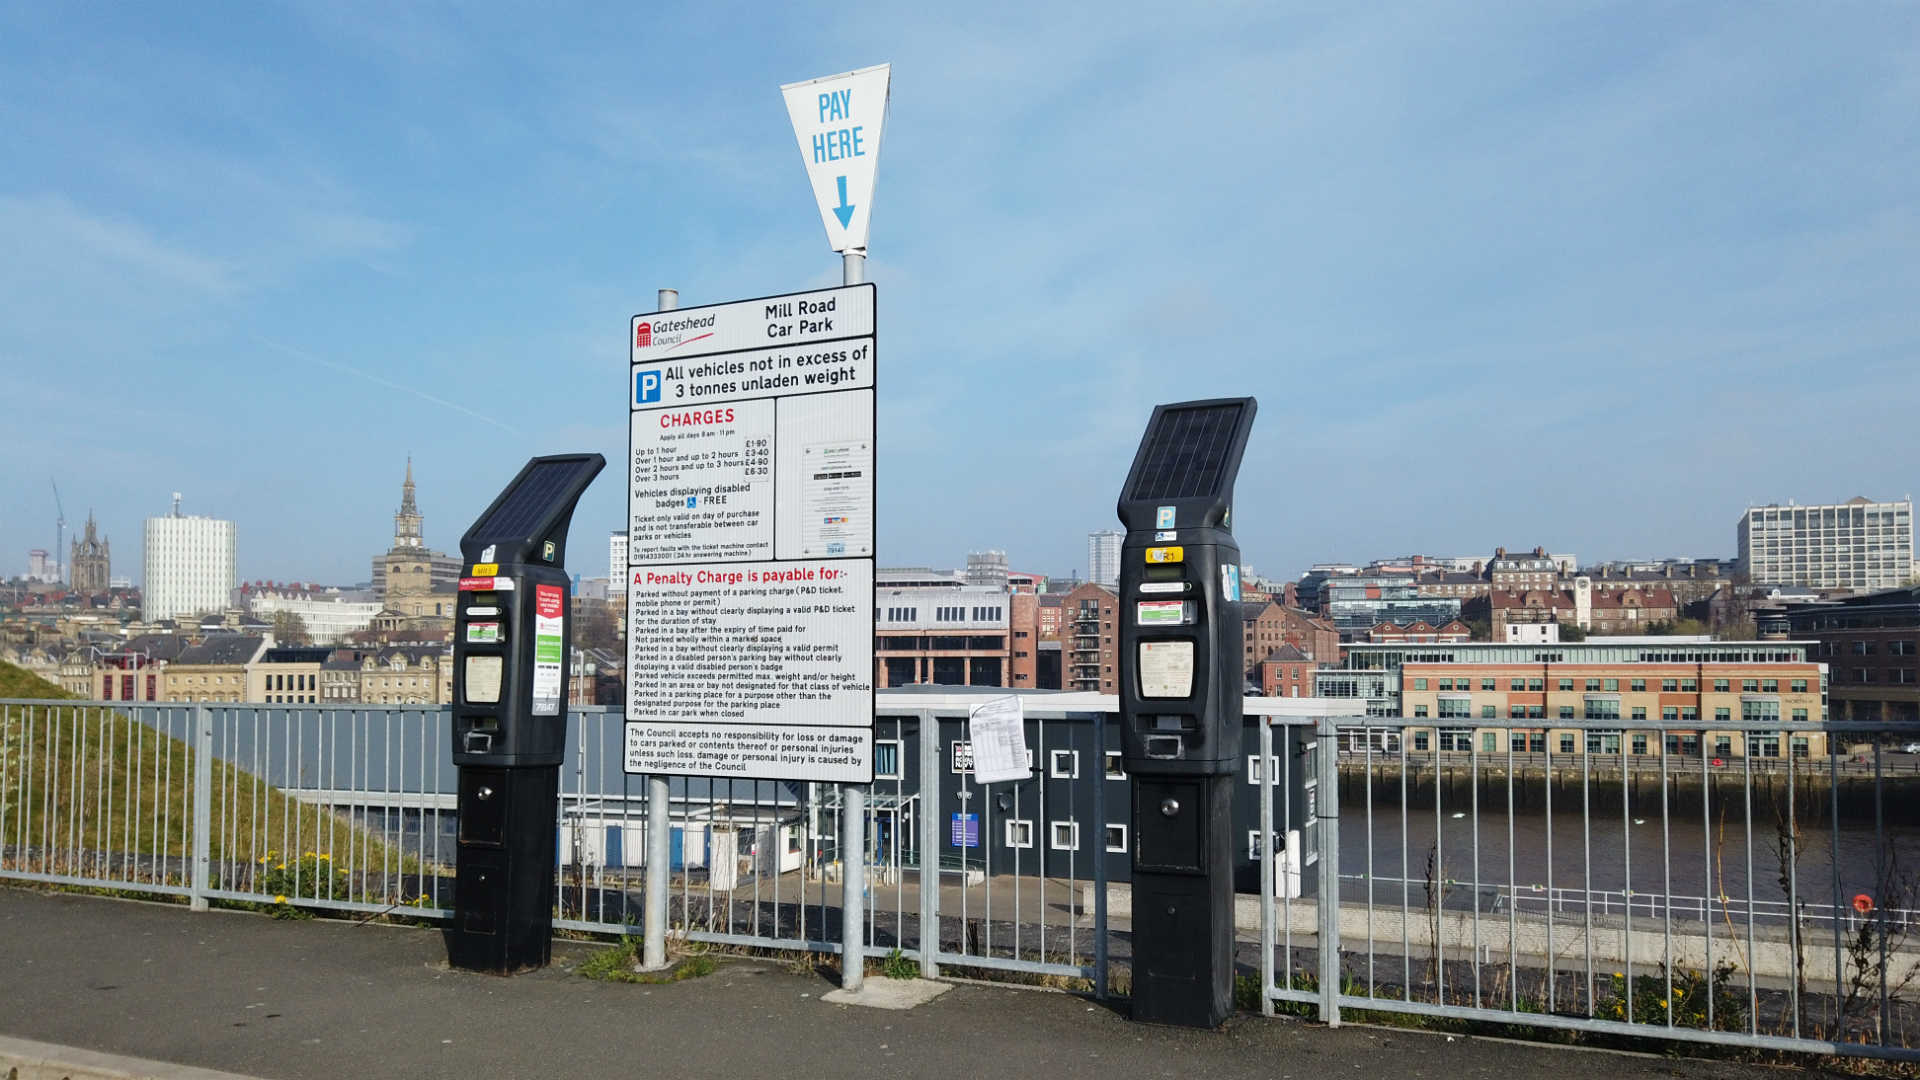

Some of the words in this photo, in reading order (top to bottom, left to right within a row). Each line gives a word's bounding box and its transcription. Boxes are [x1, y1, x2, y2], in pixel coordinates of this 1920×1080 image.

[818, 88, 851, 124] PAY
[812, 126, 865, 164] HERE
[765, 302, 793, 320] Mill
[798, 296, 836, 316] Road
[652, 313, 716, 334] Gateshead
[767, 323, 793, 338] Car
[799, 316, 833, 335] Park
[652, 334, 682, 346] Council
[665, 366, 684, 381] All
[688, 360, 745, 379] vehicles
[749, 356, 774, 372] not
[778, 354, 791, 369] in
[796, 351, 847, 367] excess
[852, 344, 868, 361] of
[642, 374, 658, 401] P
[675, 384, 685, 398] 3
[689, 381, 737, 397] tonnes
[741, 374, 799, 391] unladen
[804, 366, 856, 385] weight
[660, 408, 735, 429] CHARGES
[635, 448, 646, 457] Up
[635, 457, 651, 465] Over
[676, 454, 689, 462] and
[690, 454, 700, 462] up
[718, 451, 739, 459] hours
[635, 466, 651, 474] Over
[659, 464, 679, 472] hours
[681, 462, 694, 471] and
[706, 461, 715, 469] to
[723, 459, 744, 467] hours
[635, 475, 651, 483] Over
[634, 488, 668, 499] Vehicles
[669, 487, 712, 497] displaying
[714, 482, 751, 494] disabled
[655, 498, 685, 509] badges
[703, 494, 727, 505] FREE
[634, 515, 655, 523] Ticket
[656, 514, 671, 523] only
[673, 513, 690, 521] valid
[702, 512, 715, 520] day
[726, 510, 760, 520] purchase
[633, 524, 646, 533] and
[655, 523, 668, 531] not
[669, 521, 712, 530] transferable
[713, 520, 745, 528] between
[633, 533, 653, 542] parks
[663, 531, 692, 540] vehicles
[633, 572, 642, 585] A
[647, 571, 693, 586] Penalty
[697, 570, 743, 585] Charge
[748, 569, 758, 582] is
[762, 567, 815, 584] payable
[635, 617, 645, 625] for
[647, 617, 659, 625] the
[660, 617, 690, 625] duration
[691, 616, 700, 625] of
[701, 617, 717, 626] stay
[635, 626, 660, 634] Parked
[675, 626, 689, 635] bay
[690, 626, 708, 634] after
[710, 625, 722, 634] the
[724, 625, 746, 635] expiry
[748, 625, 757, 633] of
[776, 624, 793, 634] paid
[794, 624, 806, 633] for
[635, 635, 648, 644] Not
[649, 635, 674, 644] parked
[675, 635, 699, 644] wholly
[701, 635, 724, 643] within
[731, 634, 759, 643] marked
[760, 635, 782, 644] space
[634, 671, 659, 680] Parked
[660, 672, 685, 680] vehicle
[686, 672, 716, 680] exceeds
[717, 672, 754, 681] permitted
[775, 672, 800, 682] weight
[830, 673, 855, 682] height
[633, 707, 658, 716] Parked
[659, 708, 667, 716] in
[681, 709, 697, 717] park
[699, 708, 719, 717] when
[720, 709, 745, 718] closed
[630, 728, 645, 737] The
[646, 728, 676, 738] Council
[678, 729, 709, 739] accepts
[711, 731, 722, 739] no
[724, 731, 780, 742] responsibility
[782, 731, 795, 741] for
[797, 732, 815, 742] loss
[817, 734, 826, 742] or
[828, 733, 863, 744] damage
[630, 738, 638, 747] to
[659, 739, 686, 749] parked
[687, 741, 697, 749] or
[699, 741, 735, 750] contents
[737, 741, 768, 751] thereof
[781, 744, 818, 753] personal
[821, 744, 854, 755] injuries
[629, 748, 655, 757] unless
[656, 749, 675, 758] such
[697, 751, 729, 762] damage
[742, 753, 778, 762] personal
[780, 753, 806, 765] injury
[817, 755, 849, 765] caused
[850, 756, 862, 767] by
[629, 758, 642, 767] the
[644, 759, 687, 770] negligence
[688, 761, 697, 769] of
[699, 761, 712, 770] the
[714, 761, 746, 771] Council
